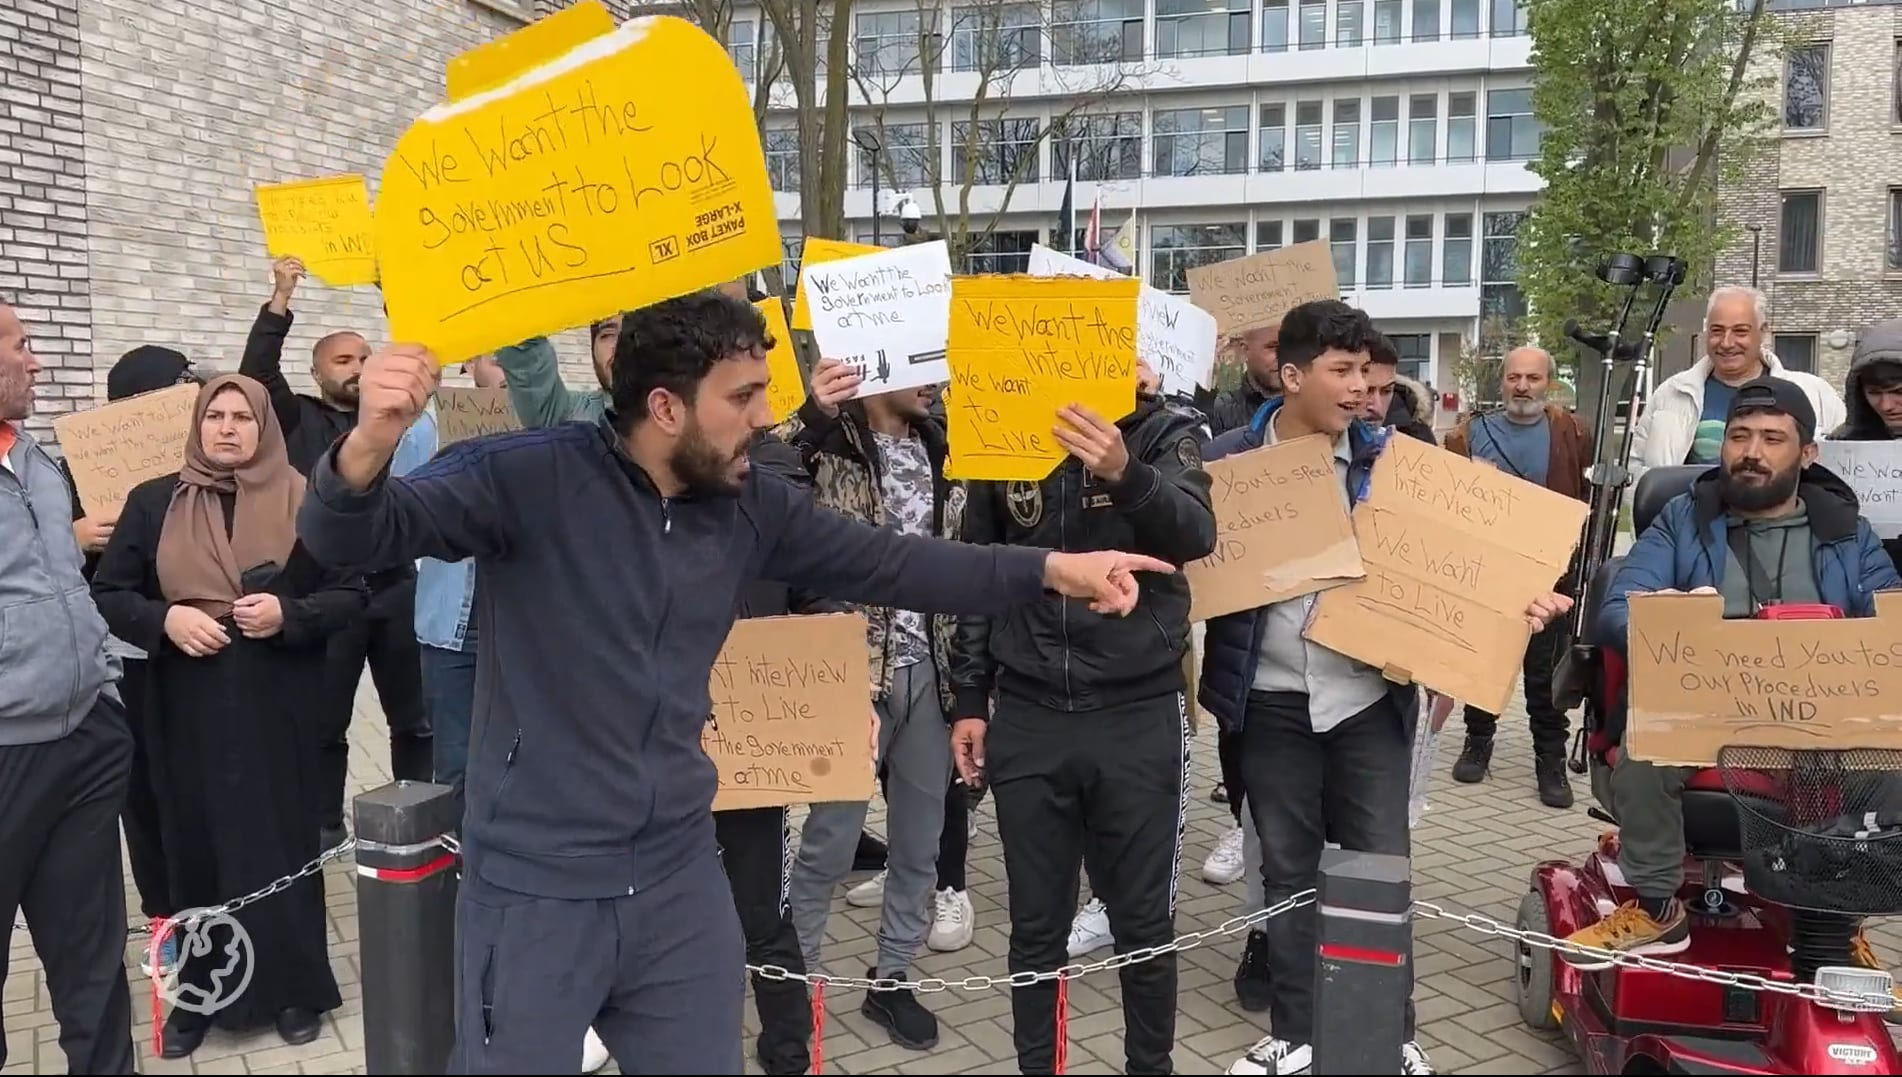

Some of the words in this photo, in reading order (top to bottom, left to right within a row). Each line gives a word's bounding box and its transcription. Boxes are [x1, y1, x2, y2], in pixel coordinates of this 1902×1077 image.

[400, 139, 472, 190] We
[465, 92, 570, 175] Want
[570, 80, 654, 144] the
[571, 165, 618, 214] to
[686, 230, 709, 247] BOX
[711, 216, 745, 239] PAKET
[461, 235, 508, 292] at
[655, 241, 673, 257] XL
[811, 273, 839, 295] We
[840, 269, 887, 291] Want
[886, 265, 912, 284] the
[901, 285, 914, 298] to
[1198, 271, 1224, 290] We
[868, 310, 905, 327] me
[963, 301, 1009, 333] We
[1006, 302, 1086, 346] Want
[1087, 306, 1138, 350] the
[952, 364, 987, 391] We
[990, 370, 1033, 396] Want
[432, 391, 470, 412] We
[962, 400, 999, 423] to
[102, 411, 145, 434] Want
[970, 418, 1048, 453] Live
[1391, 440, 1434, 481] We
[1444, 460, 1520, 516] Want
[1838, 456, 1866, 479] We
[1219, 469, 1263, 503] You
[1263, 468, 1288, 486] to
[1372, 512, 1411, 563] We
[1420, 539, 1485, 590] Want
[1414, 584, 1466, 629] Live
[1638, 628, 1702, 666] We
[1715, 636, 1786, 669] need
[1854, 640, 1890, 668] to
[722, 695, 754, 724] to
[762, 693, 818, 722] Live
[1734, 696, 1760, 717] in
[1767, 697, 1817, 722] IND
[712, 728, 746, 756] the
[734, 763, 761, 787] at
[761, 767, 813, 788] me
